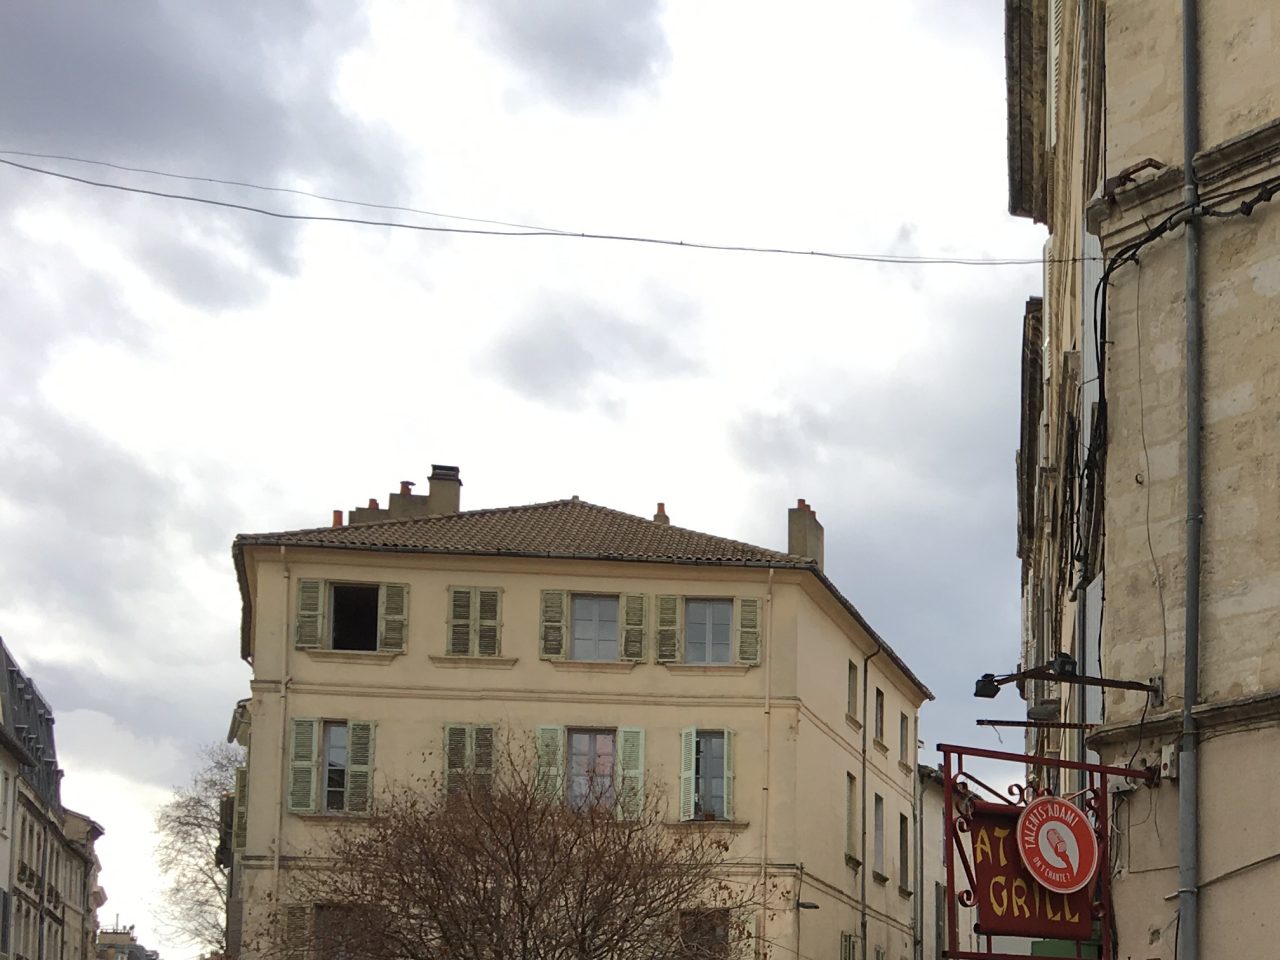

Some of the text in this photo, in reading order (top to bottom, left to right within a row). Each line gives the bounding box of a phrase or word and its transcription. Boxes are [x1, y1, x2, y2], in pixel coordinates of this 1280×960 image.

[1025, 805, 1046, 849] TALENTS
[1046, 803, 1079, 827] ADAMI
[990, 876, 1080, 923] GRILL
